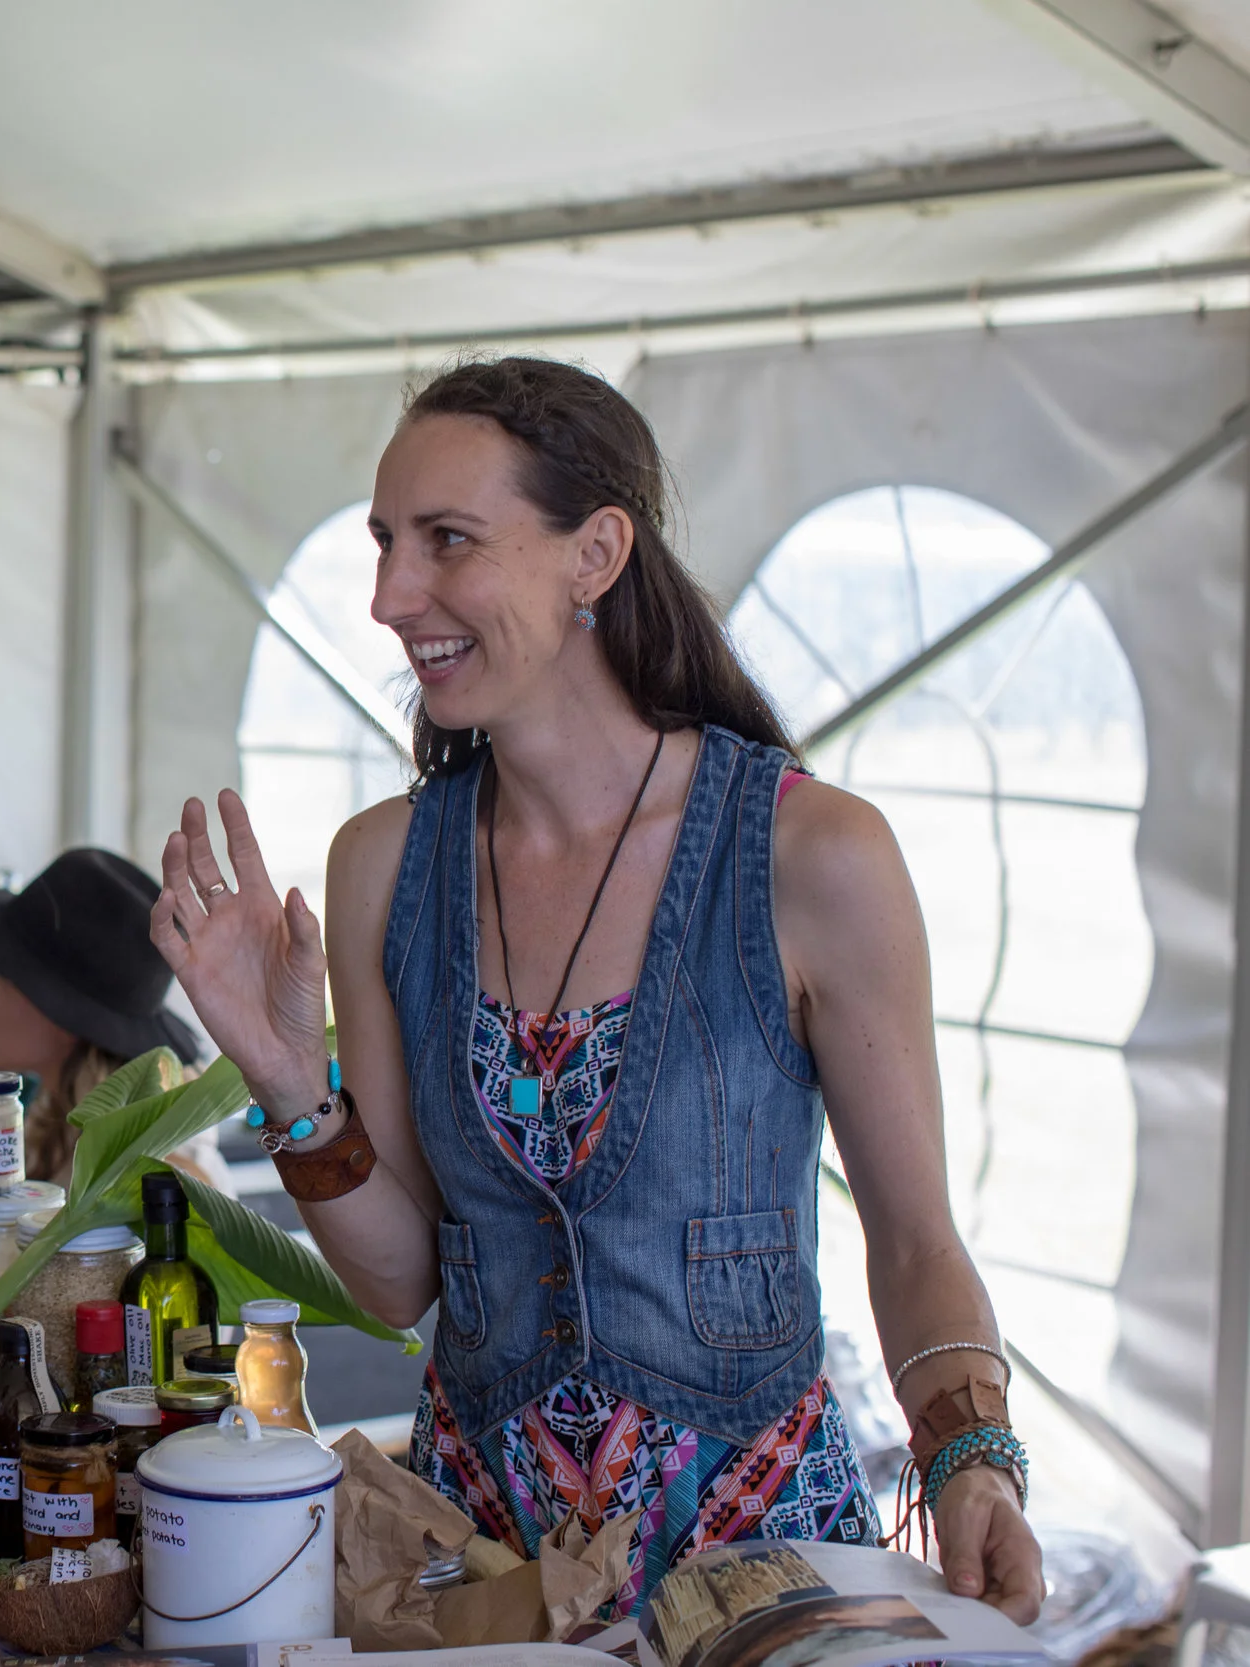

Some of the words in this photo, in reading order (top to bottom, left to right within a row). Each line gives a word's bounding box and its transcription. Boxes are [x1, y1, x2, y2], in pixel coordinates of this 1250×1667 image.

[44, 1496, 78, 1508] with
[23, 1504, 46, 1519] tard
[55, 1509, 81, 1521] and
[145, 1505, 184, 1527] potato
[151, 1529, 186, 1547] potato
